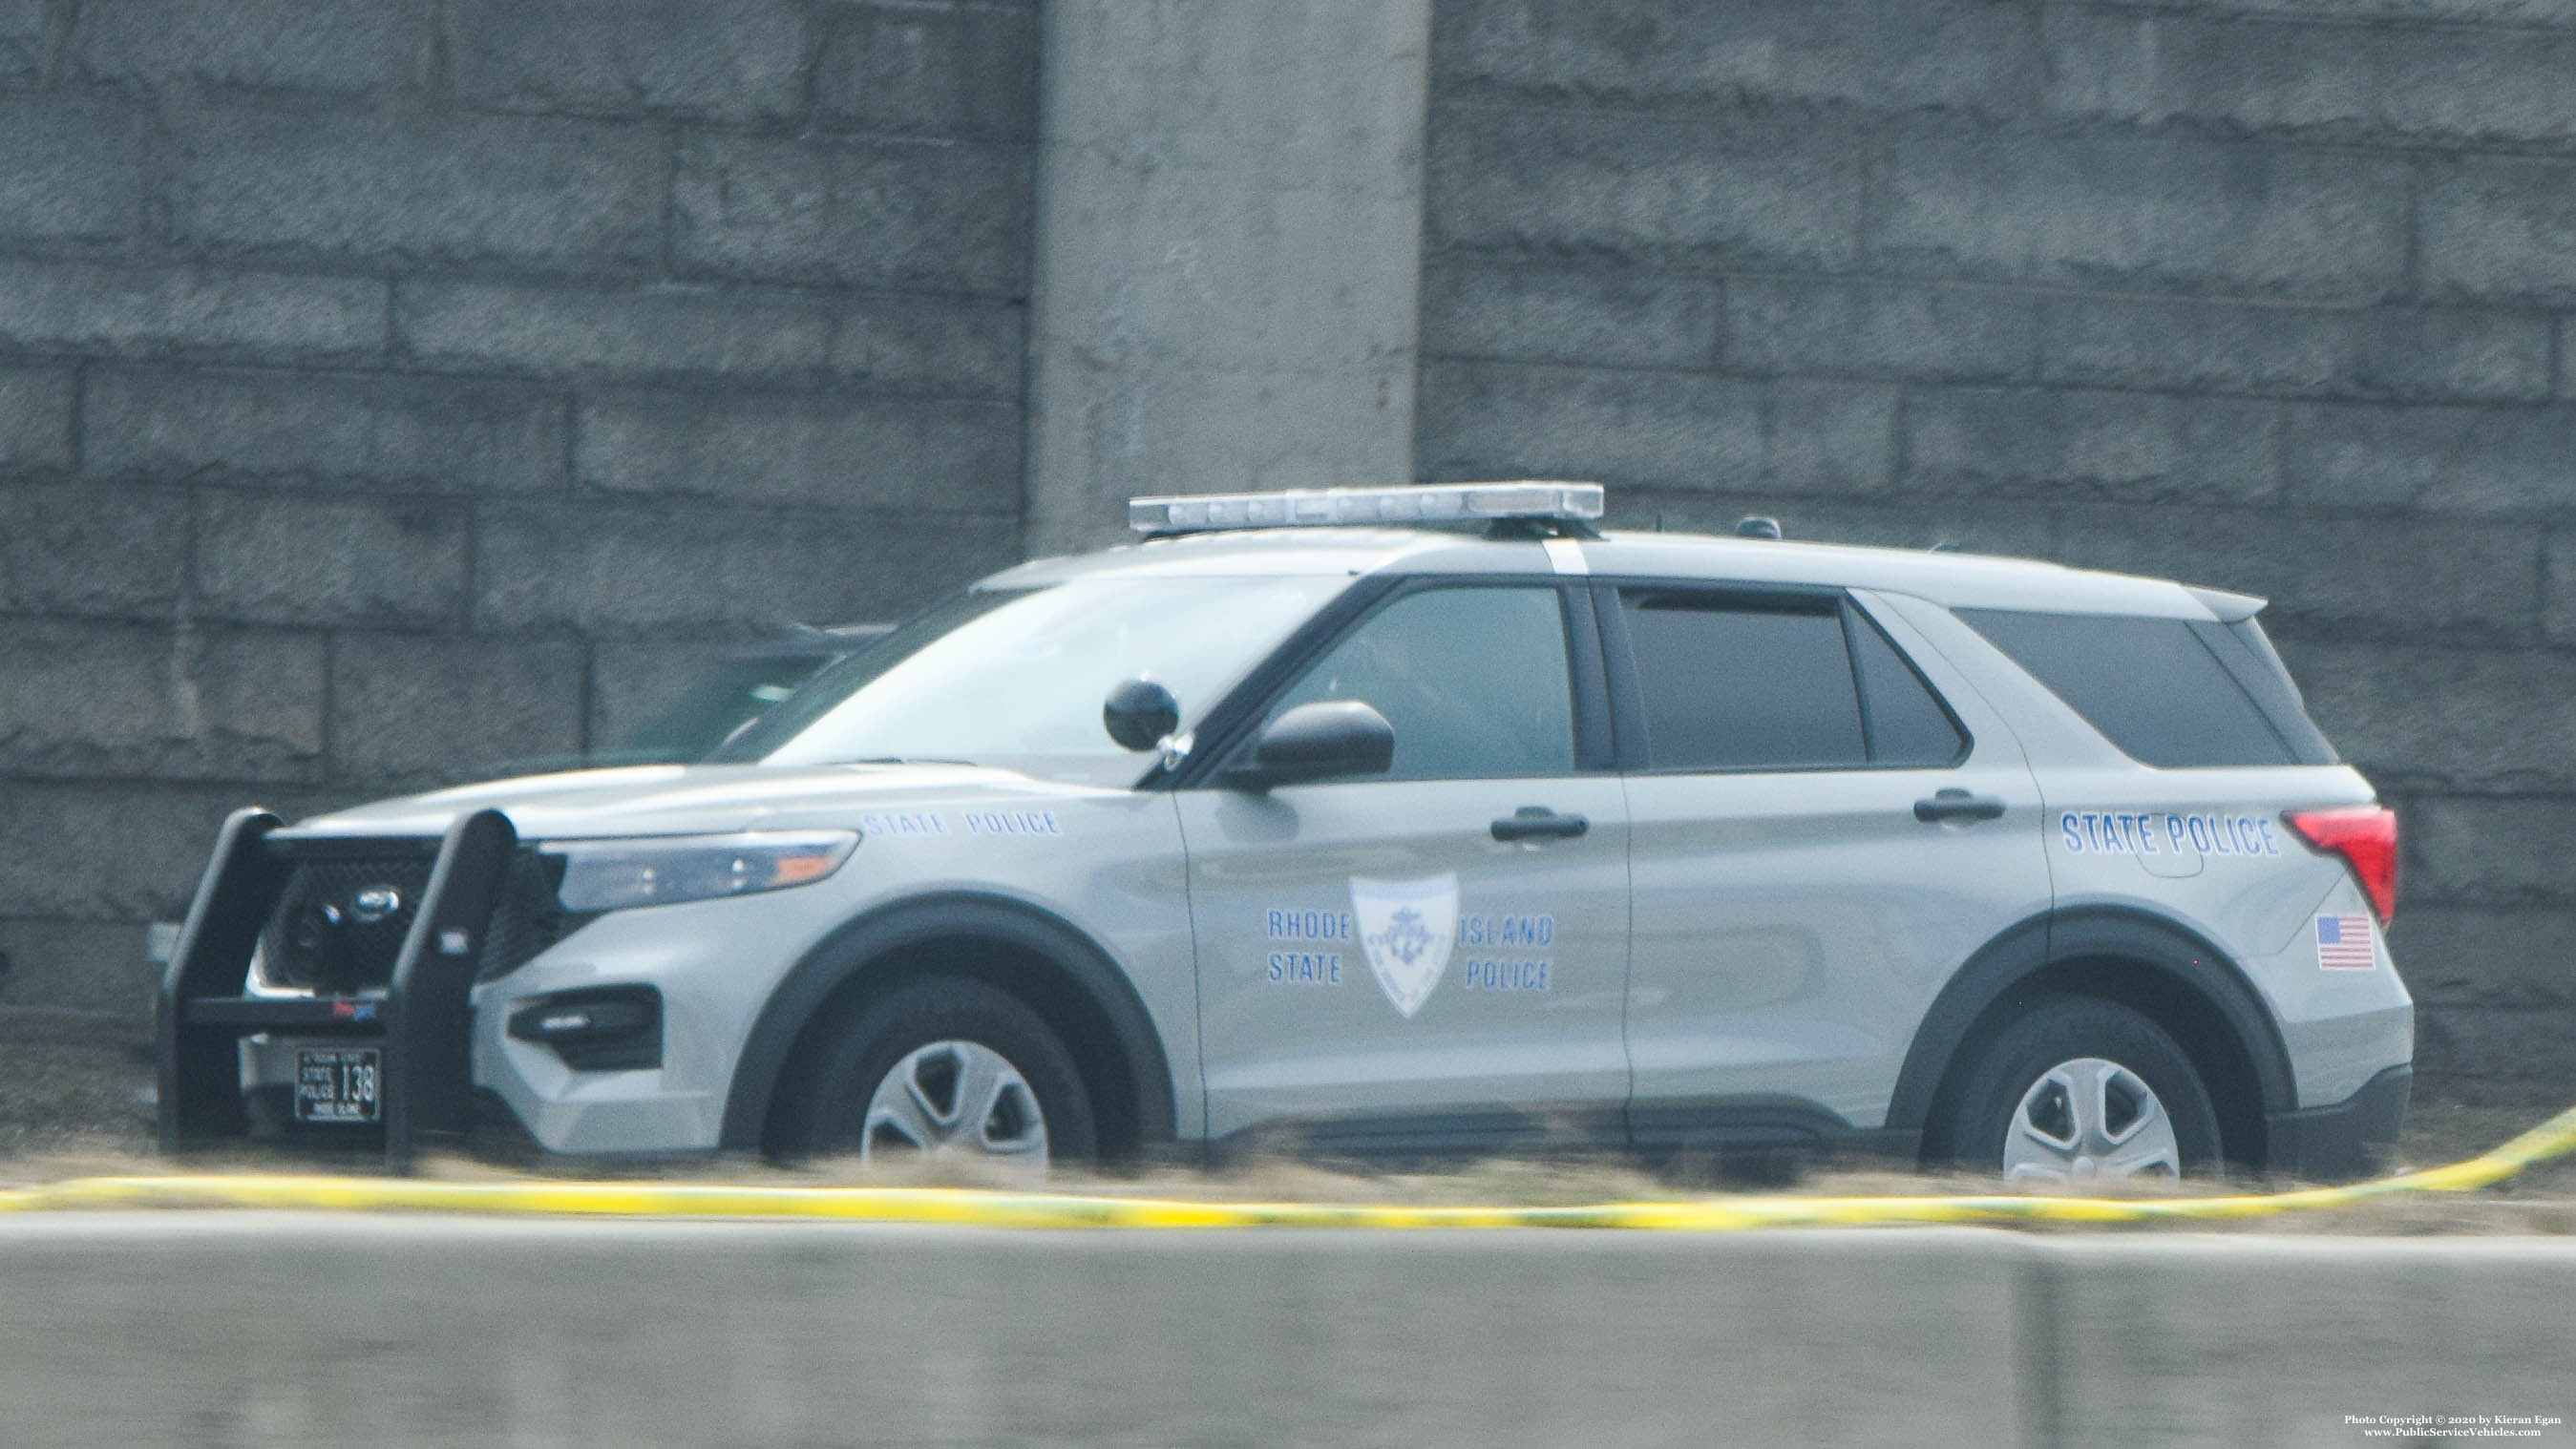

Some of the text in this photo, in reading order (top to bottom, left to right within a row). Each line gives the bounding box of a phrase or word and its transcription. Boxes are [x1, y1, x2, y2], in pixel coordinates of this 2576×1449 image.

[863, 811, 1060, 836] STATE POLICE
[2061, 811, 2280, 856] STATE POLICE
[1267, 909, 1554, 946] RHODE ISLAND
[1267, 954, 1342, 985] STATE
[1465, 957, 1552, 991] POLICE
[343, 1064, 374, 1102] 138
